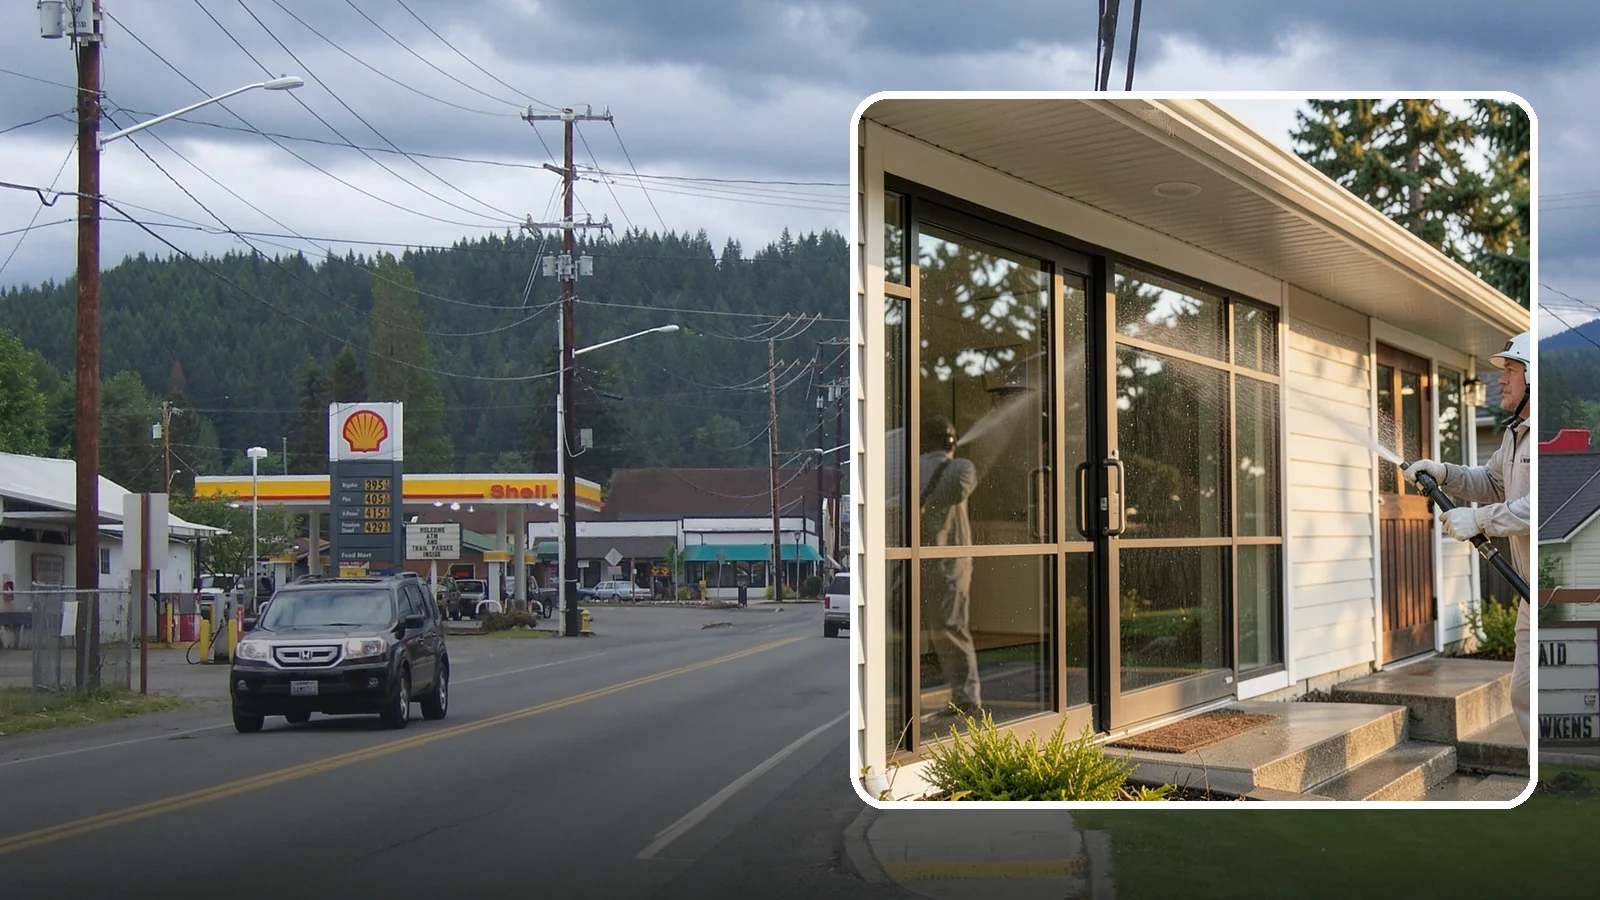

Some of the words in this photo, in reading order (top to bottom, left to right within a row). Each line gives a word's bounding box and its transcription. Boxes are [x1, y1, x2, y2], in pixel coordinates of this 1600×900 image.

[366, 480, 383, 490] 395
[490, 484, 547, 499] Shell
[366, 494, 383, 504] 405
[366, 508, 383, 518] 415
[366, 522, 383, 532] 429
